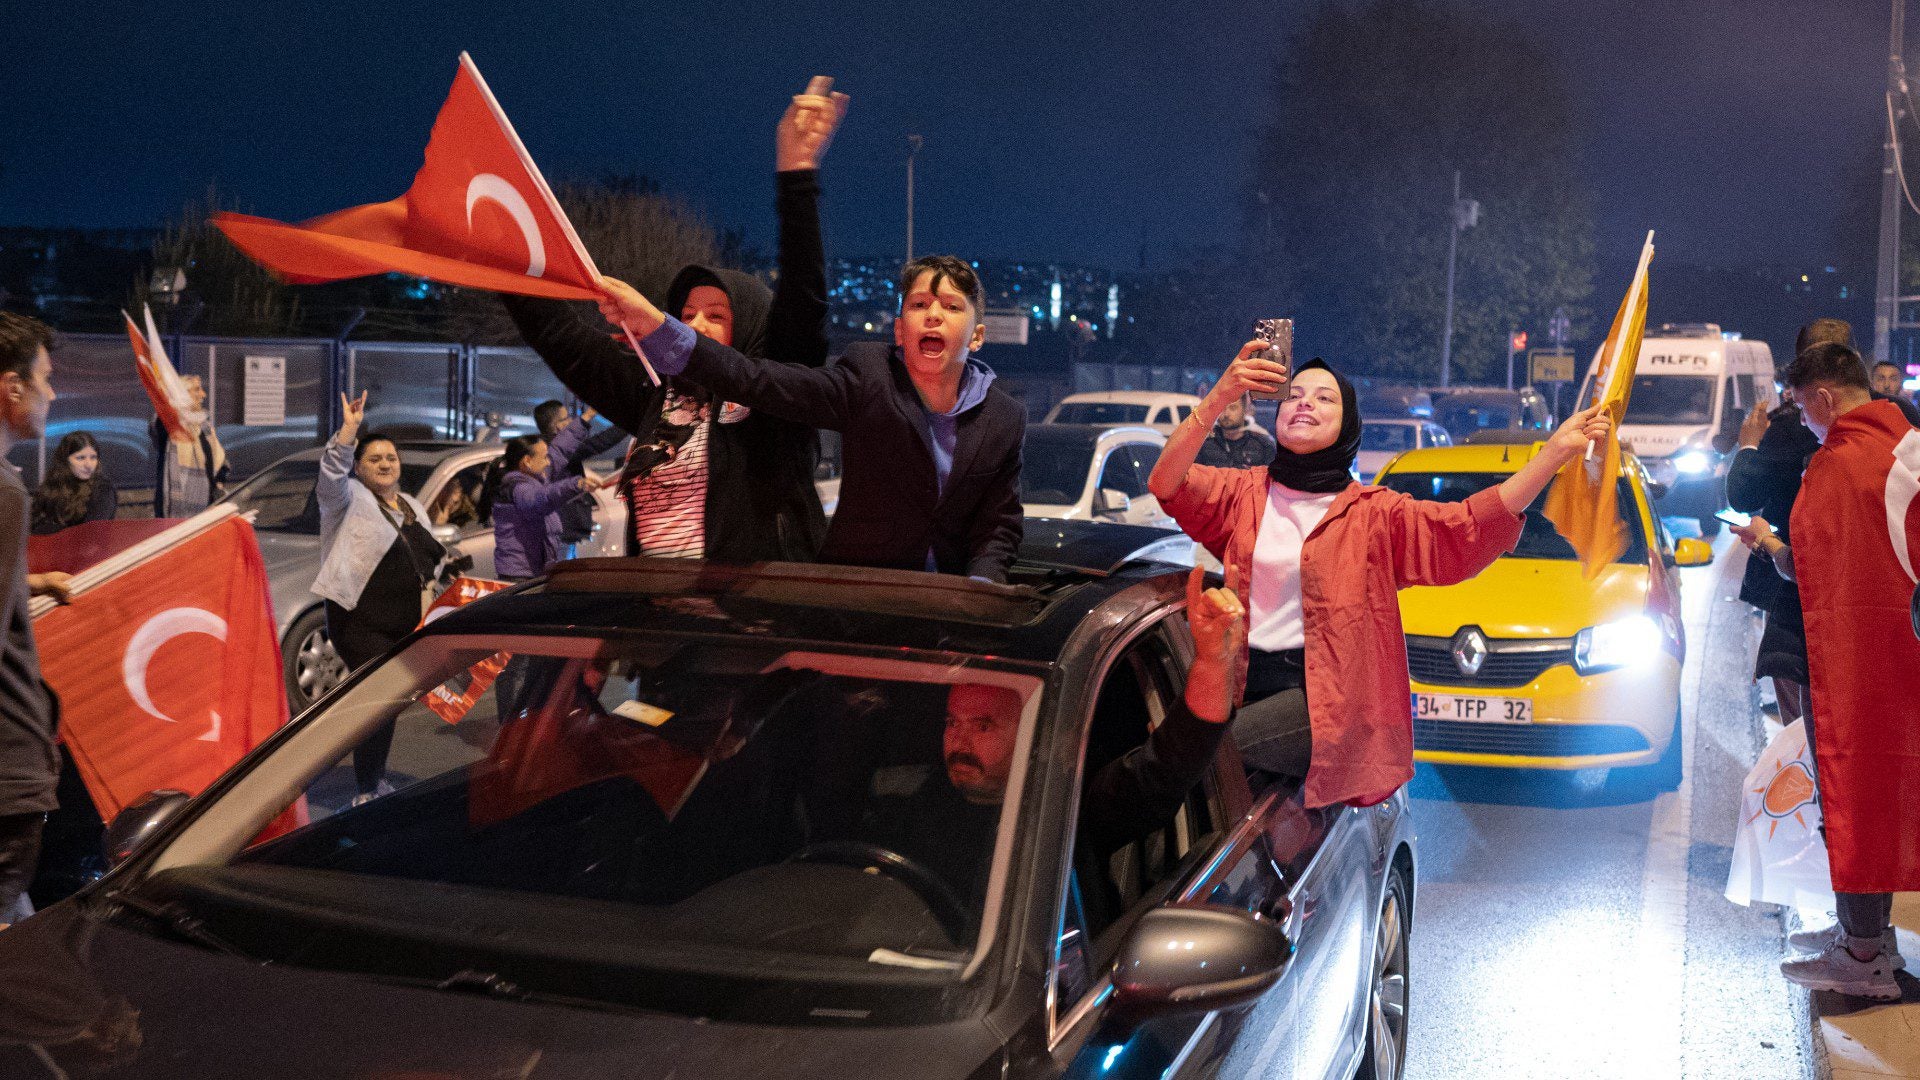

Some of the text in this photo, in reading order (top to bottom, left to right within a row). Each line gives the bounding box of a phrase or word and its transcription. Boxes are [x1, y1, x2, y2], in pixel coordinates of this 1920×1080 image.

[1651, 354, 1708, 366] ALFA
[1418, 697, 1526, 720] 34 TFP 32
